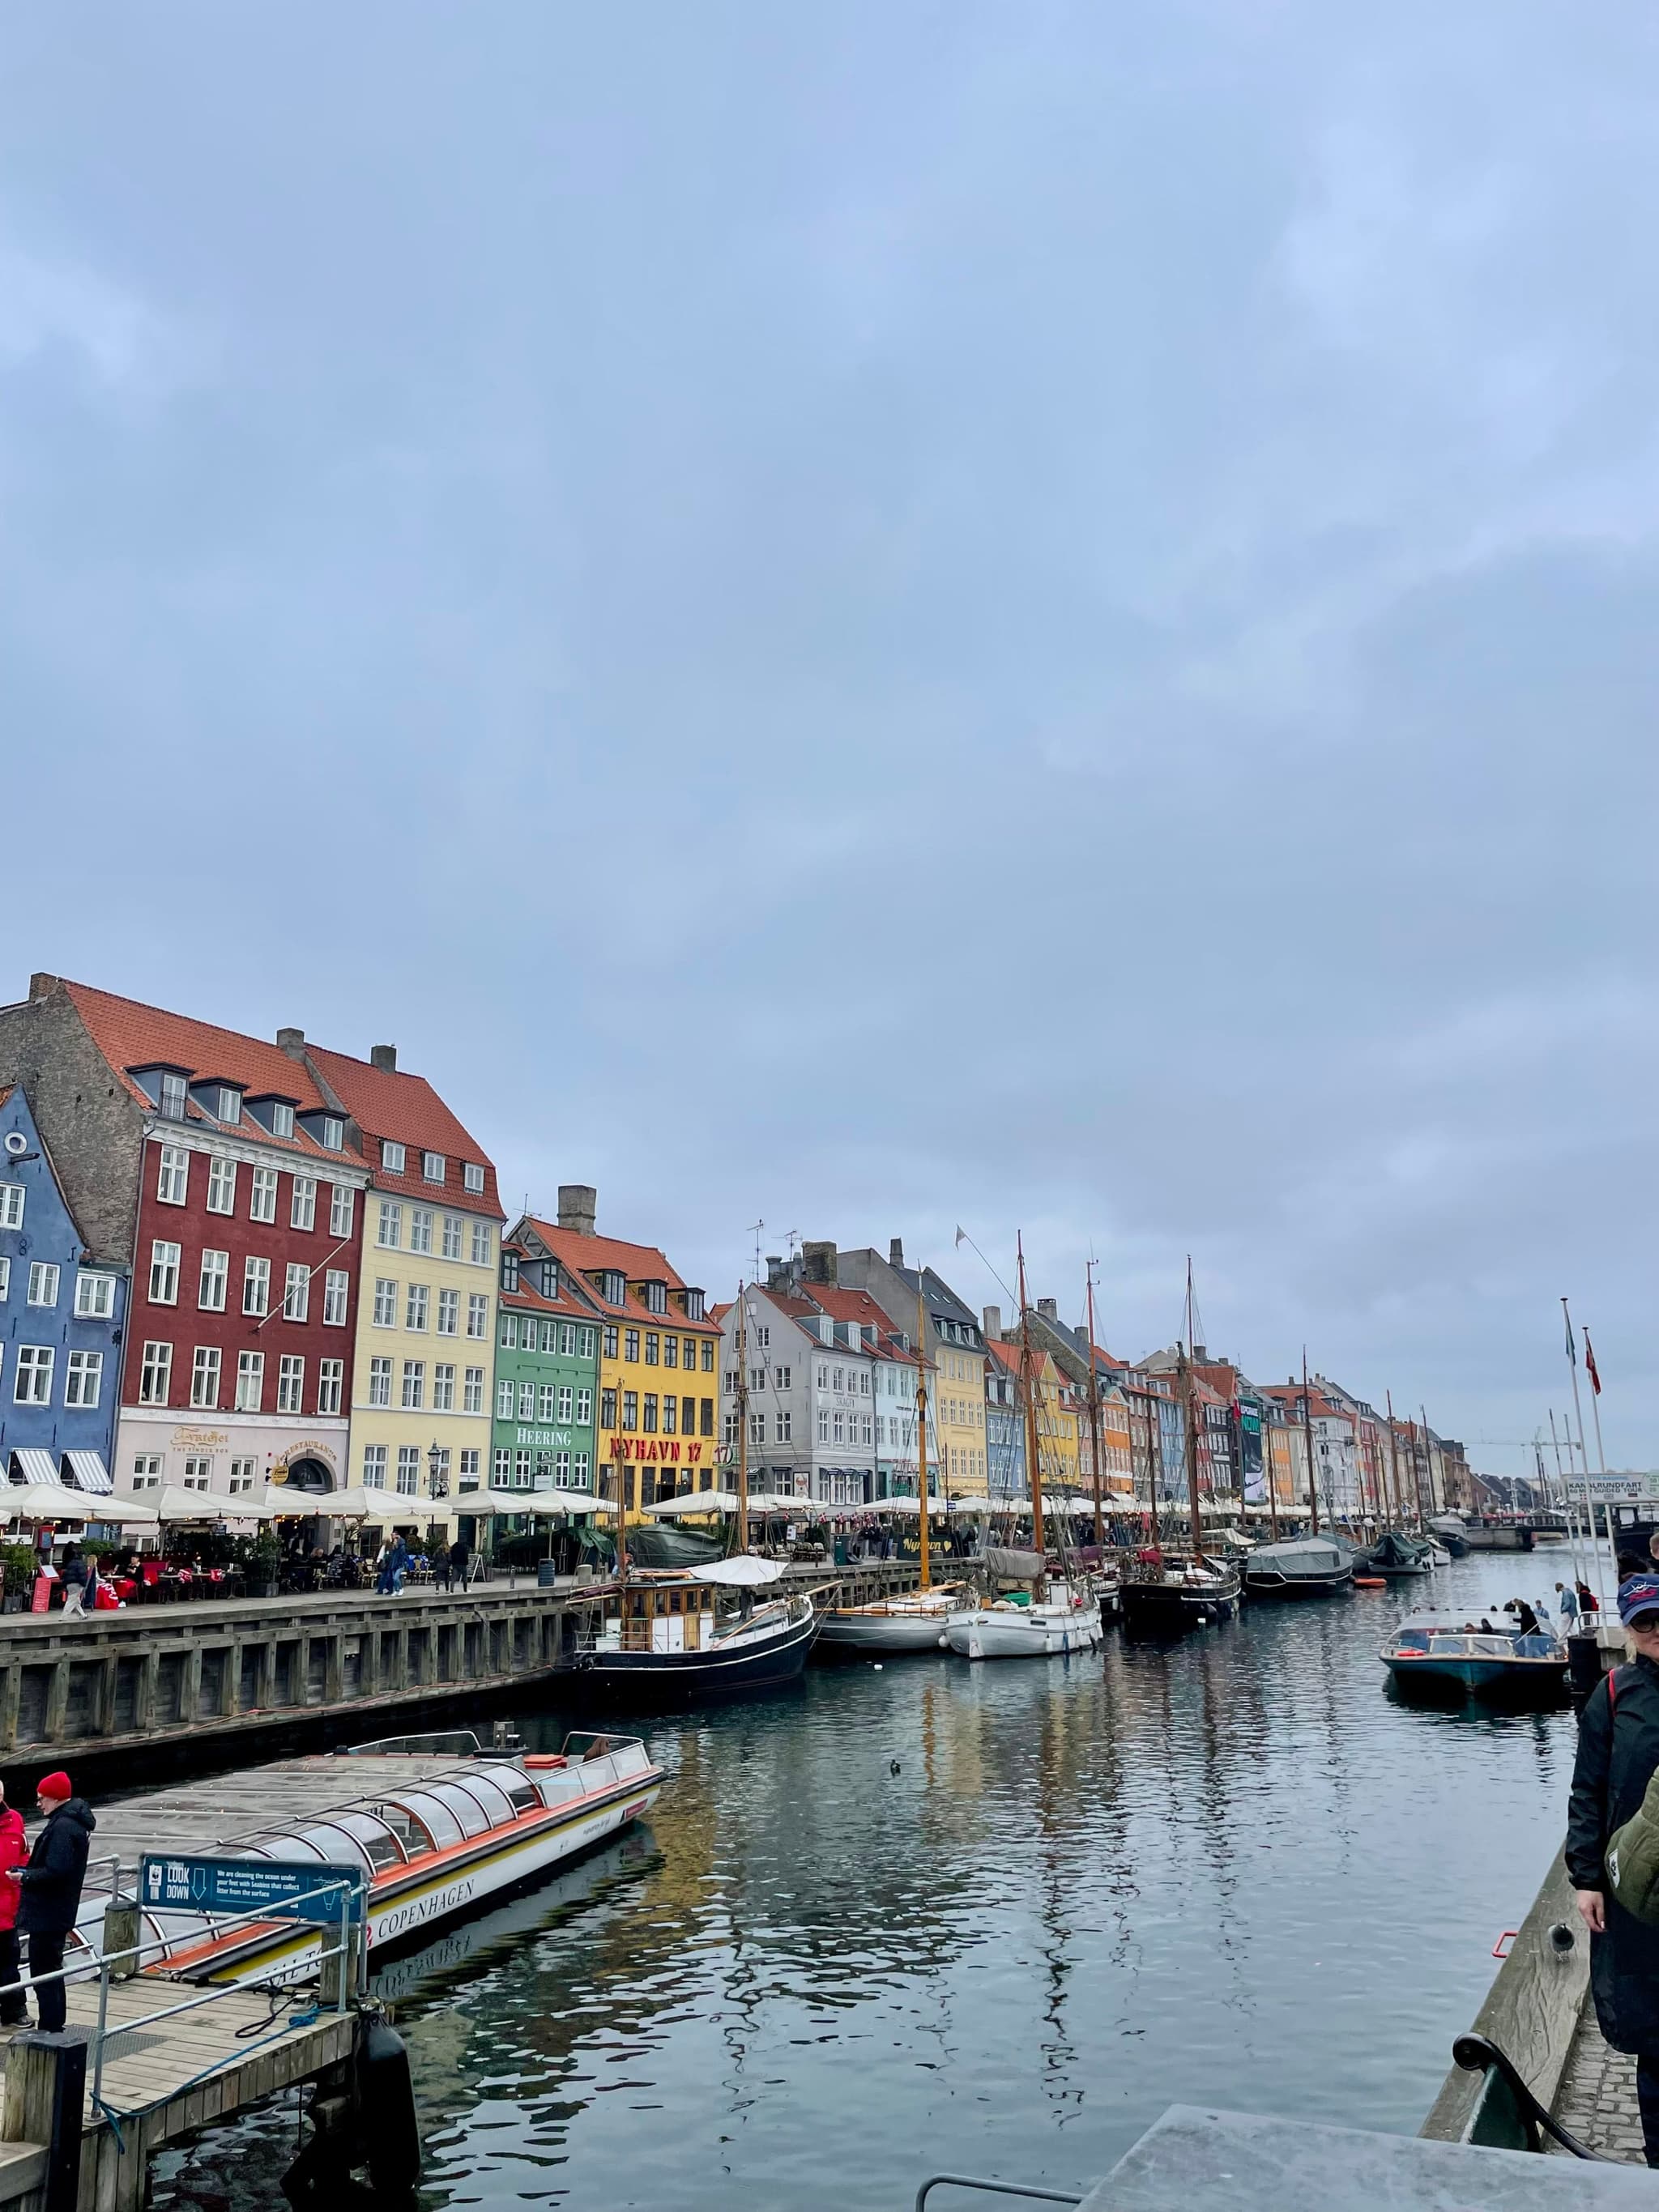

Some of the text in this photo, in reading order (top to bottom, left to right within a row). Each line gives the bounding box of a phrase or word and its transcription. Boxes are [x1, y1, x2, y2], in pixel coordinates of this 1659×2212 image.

[516, 1427, 571, 1446] HEERING
[610, 1438, 702, 1463] NYHAVN 17
[714, 1447, 728, 1464] 17
[167, 1865, 190, 1884] LOOK
[234, 1870, 254, 1880] cleaning
[166, 1885, 190, 1900] DOWN
[251, 1890, 271, 1898] surface
[378, 1878, 475, 1939] COPENHAGEN
